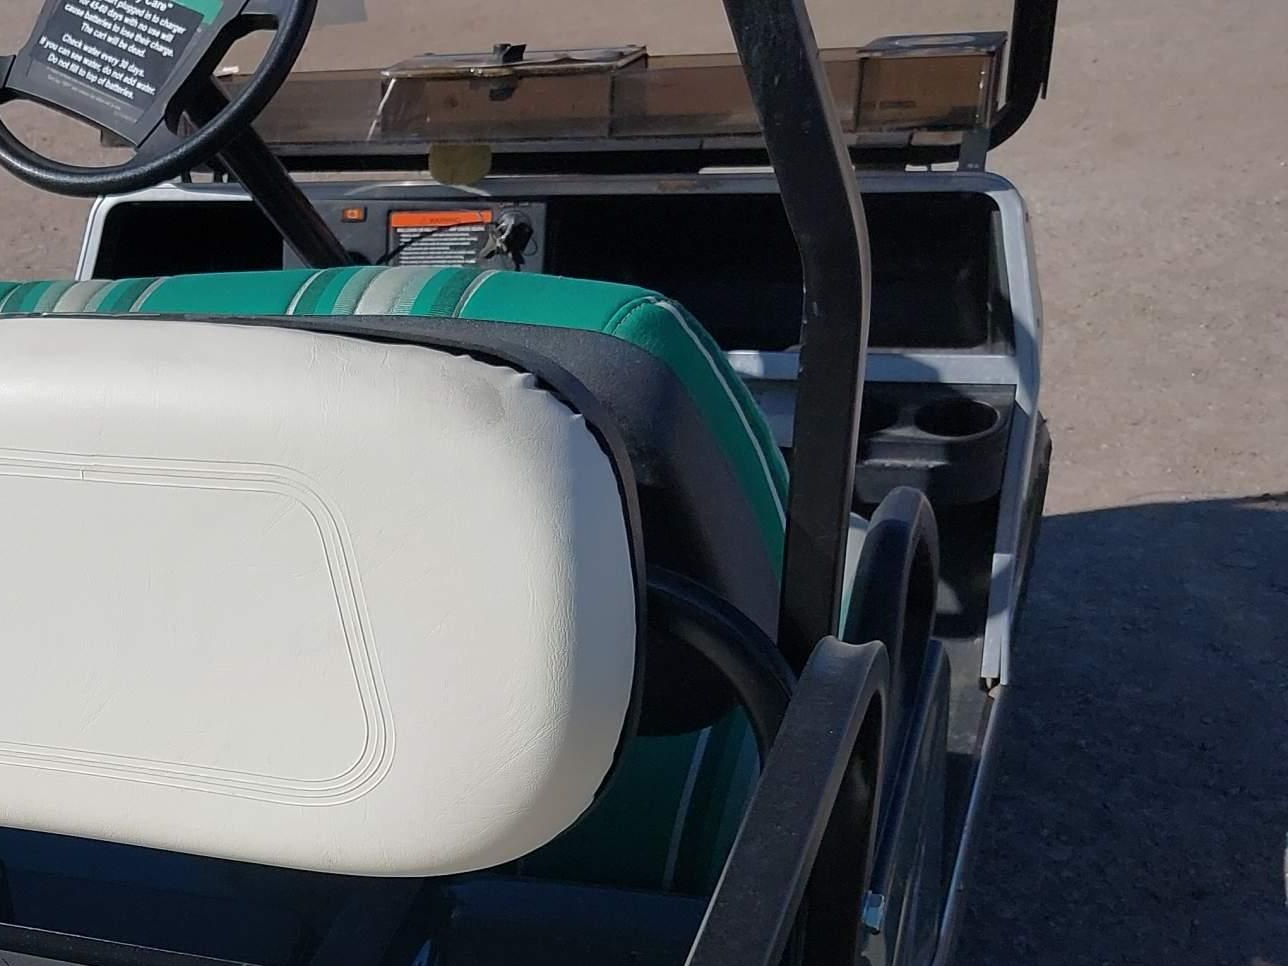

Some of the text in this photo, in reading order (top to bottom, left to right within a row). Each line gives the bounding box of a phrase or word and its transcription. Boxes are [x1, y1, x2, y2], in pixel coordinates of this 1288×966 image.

[64, 4, 85, 17] cause
[84, 10, 112, 29] batteries
[112, 22, 121, 32] to
[119, 26, 135, 39] lose
[81, 22, 93, 34] The
[93, 29, 107, 40] cart
[106, 35, 120, 46] will
[118, 39, 128, 49] be
[107, 9, 123, 21] days
[124, 16, 138, 27] with
[137, 23, 148, 31] no
[160, 32, 174, 42] will
[159, 17, 186, 34] charger
[44, 40, 58, 51] you
[57, 46, 71, 56] can
[101, 64, 112, 75] do
[111, 69, 125, 80] not
[122, 75, 138, 87] add
[62, 33, 83, 49] Check
[83, 44, 102, 57] water
[100, 52, 120, 66] every
[47, 52, 59, 64] Do
[57, 58, 70, 69] not
[68, 62, 80, 73] fill
[78, 67, 87, 77] to
[86, 71, 98, 82] top
[97, 77, 106, 86] of
